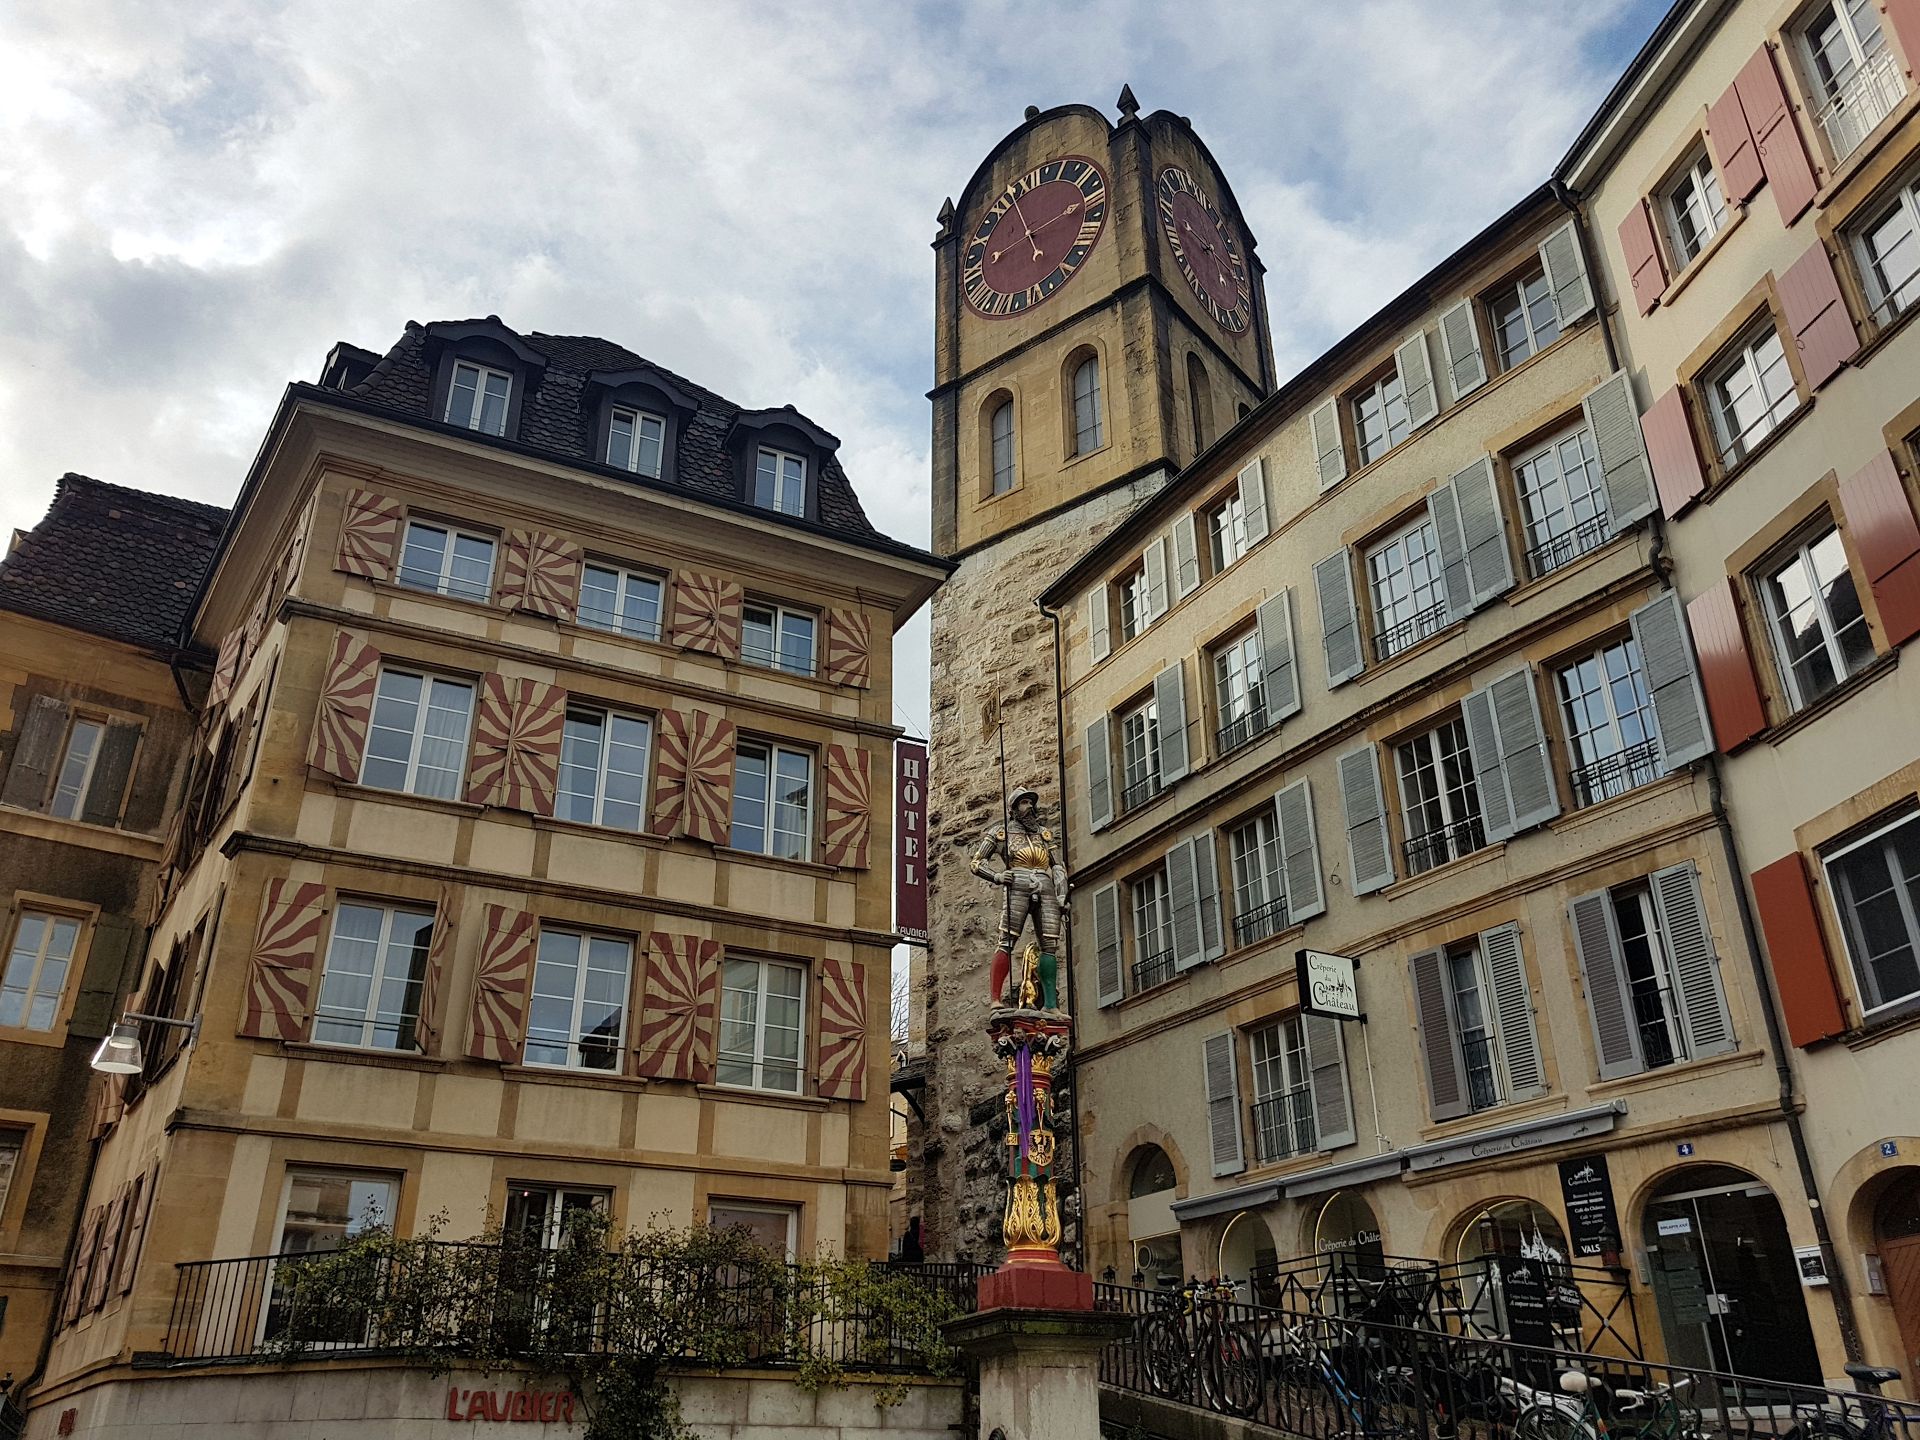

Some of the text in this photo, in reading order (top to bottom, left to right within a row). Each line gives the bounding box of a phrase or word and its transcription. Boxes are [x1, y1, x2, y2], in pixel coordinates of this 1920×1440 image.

[903, 757, 919, 886] HÔTEL
[1309, 955, 1336, 973] Crêperie
[1313, 981, 1355, 1011] Château
[1472, 1143, 1501, 1156] Crêperie
[1511, 1135, 1542, 1148] Château
[1682, 1144, 1689, 1155] 4
[1883, 1143, 1892, 1155] 2
[1319, 1237, 1347, 1252] Crêperie
[1348, 1236, 1357, 1247] du
[1580, 1243, 1601, 1254] VALS
[448, 1386, 574, 1423] L'AUBIER
